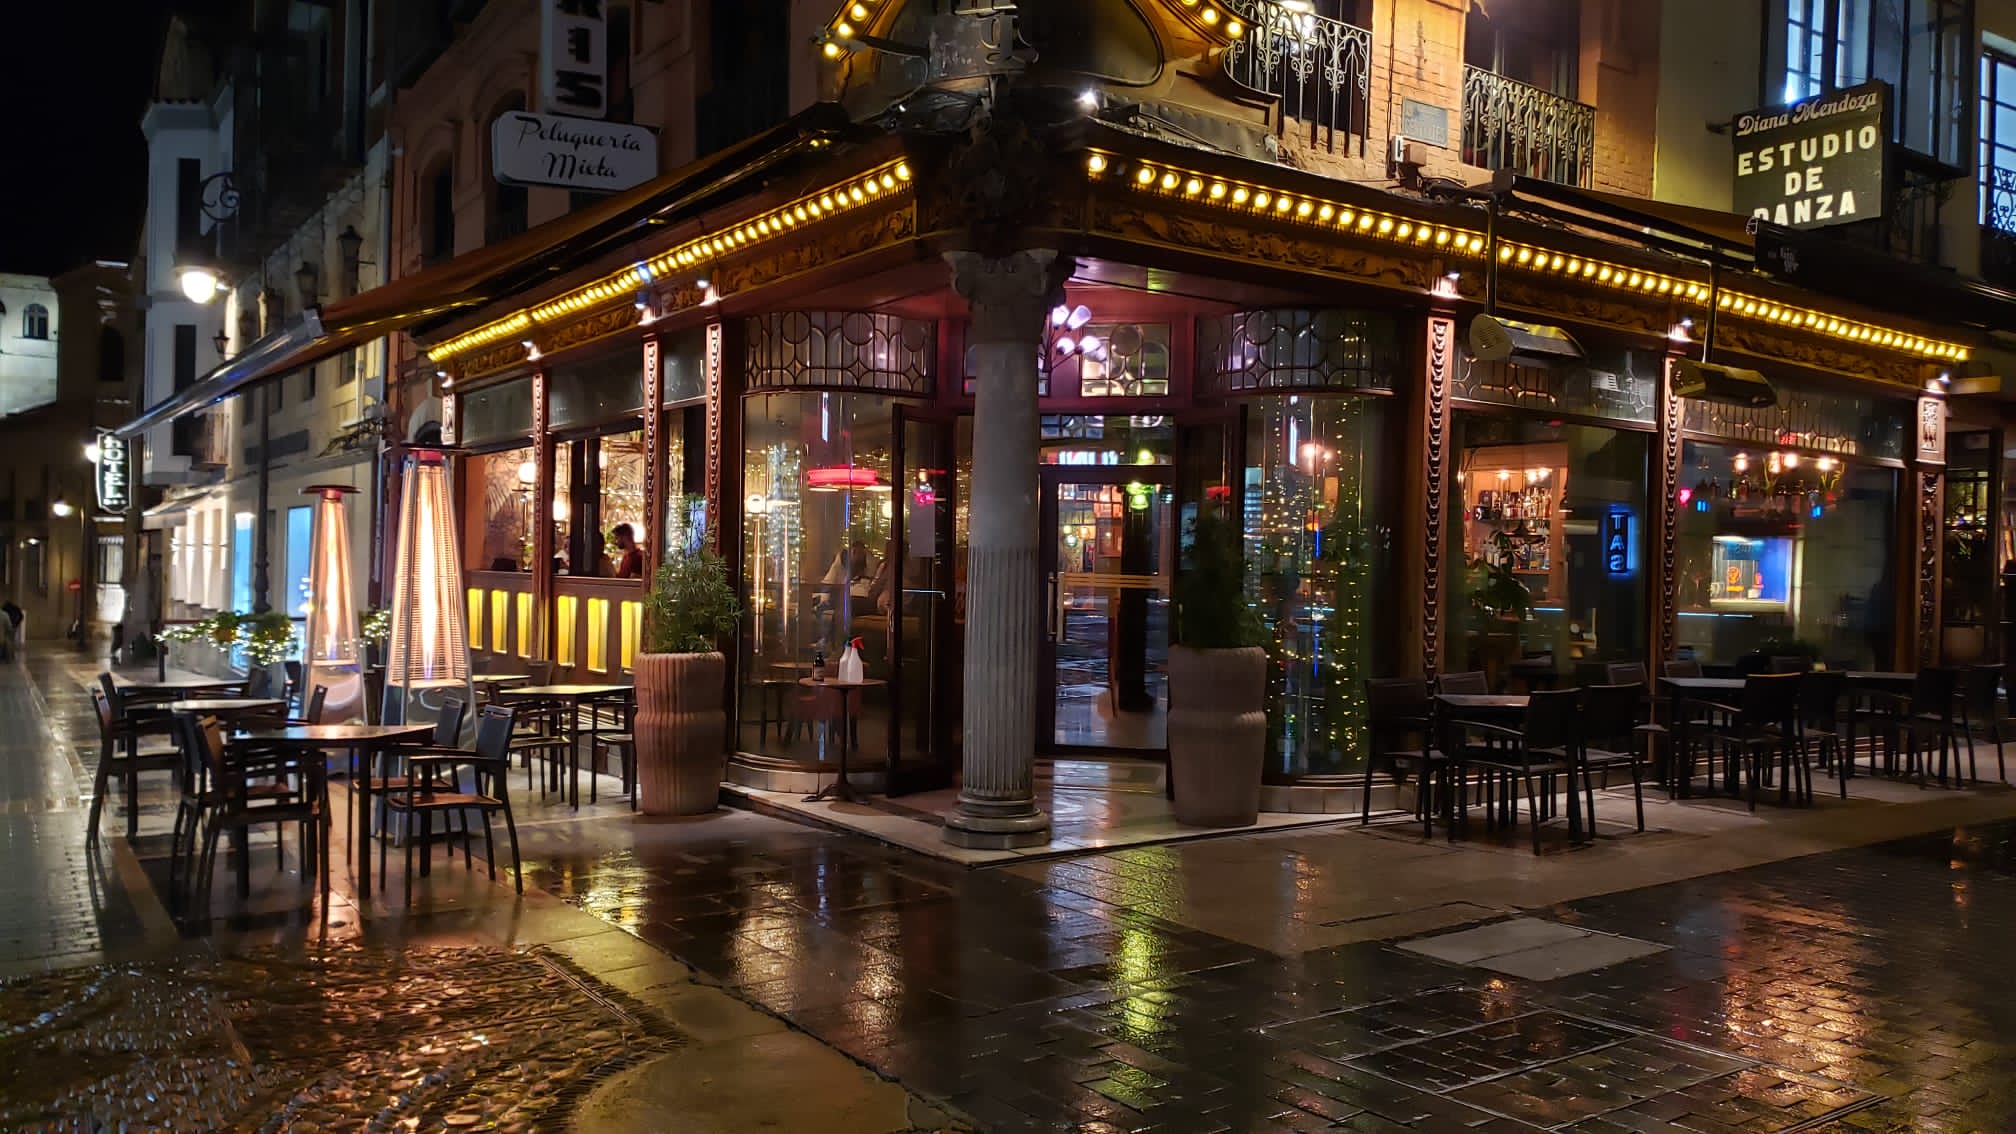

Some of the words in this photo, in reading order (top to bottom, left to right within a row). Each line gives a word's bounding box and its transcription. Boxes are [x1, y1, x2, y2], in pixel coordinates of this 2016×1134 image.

[514, 115, 641, 151] Peluquería
[1736, 112, 1788, 136] Diana
[1792, 92, 1878, 123] Mendoza
[1738, 125, 1877, 176] ESTUDIO
[1785, 166, 1824, 196] DE
